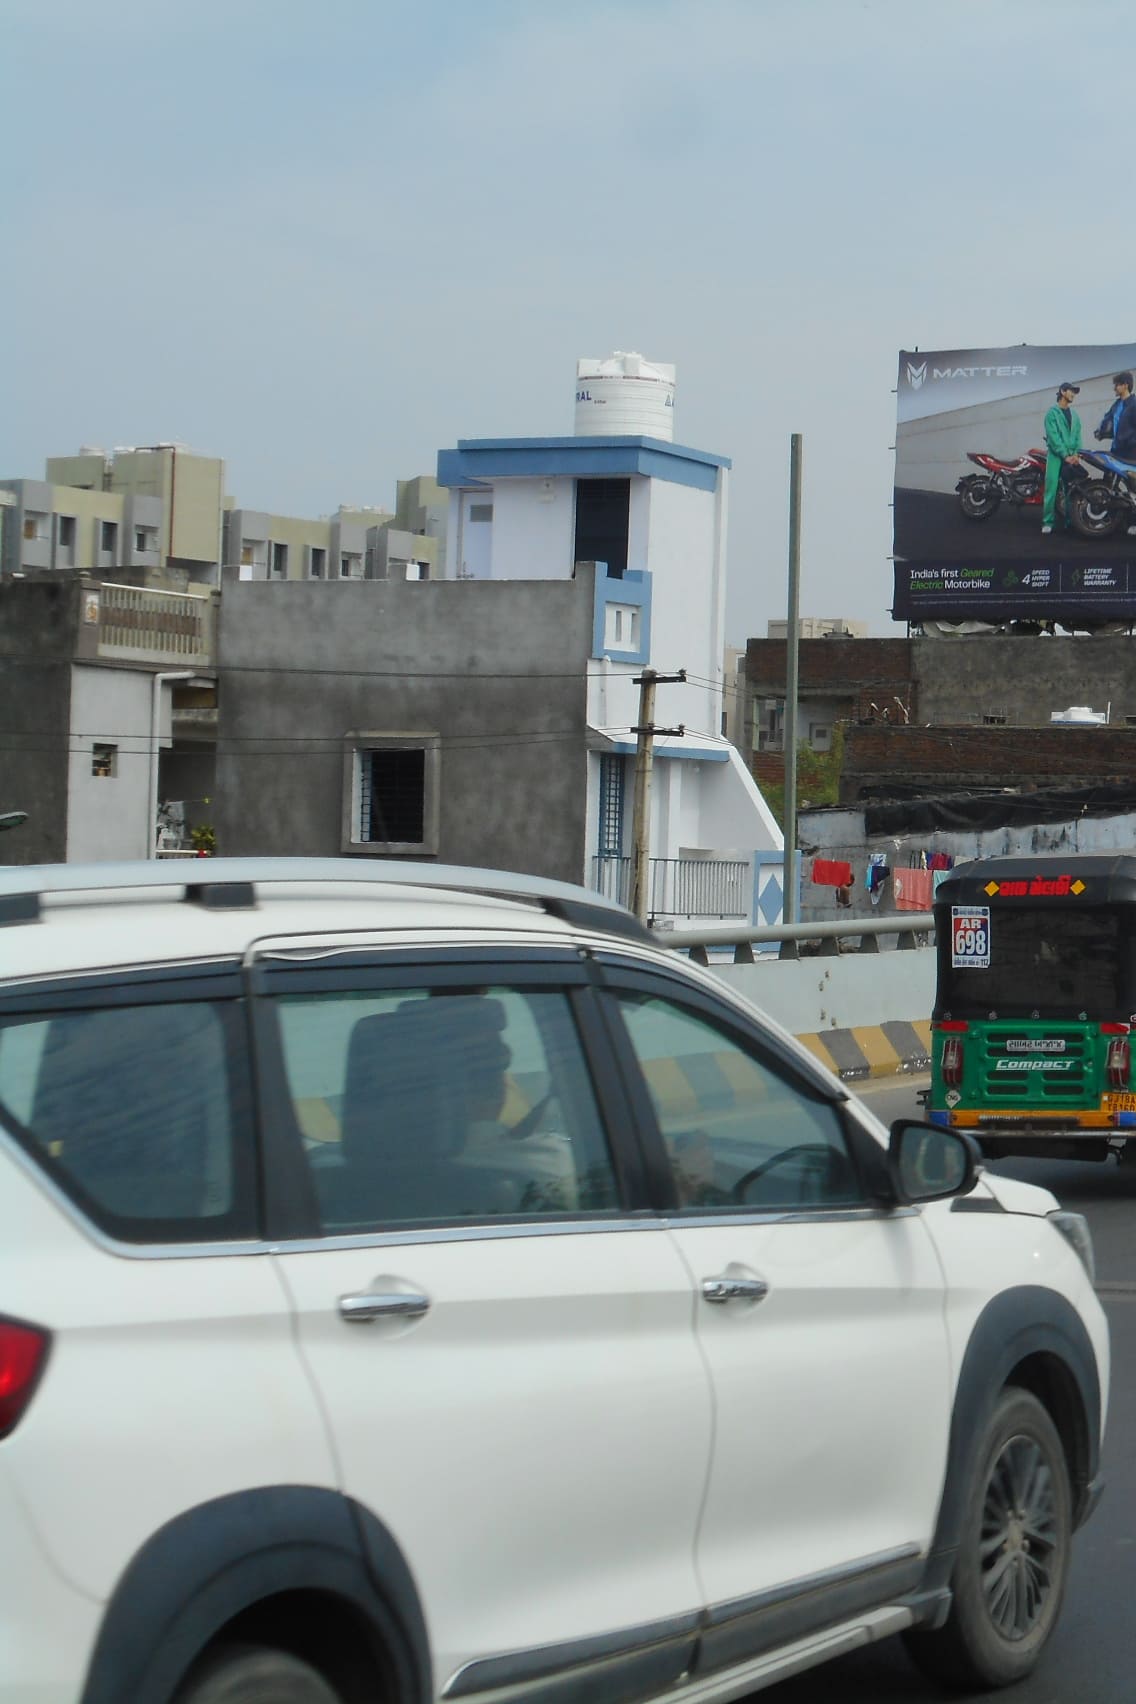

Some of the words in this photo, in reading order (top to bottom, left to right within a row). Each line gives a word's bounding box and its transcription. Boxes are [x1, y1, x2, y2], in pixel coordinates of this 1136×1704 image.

[932, 366, 1029, 379] MATTER
[910, 569, 939, 579] India's
[941, 568, 959, 578] first
[960, 568, 994, 578] Geared
[910, 580, 943, 590] Electric
[944, 579, 991, 589] Motorbike
[1022, 574, 1031, 585] 4
[960, 918, 982, 929] AR
[956, 930, 986, 955] 698
[996, 1060, 1075, 1071] Compact
